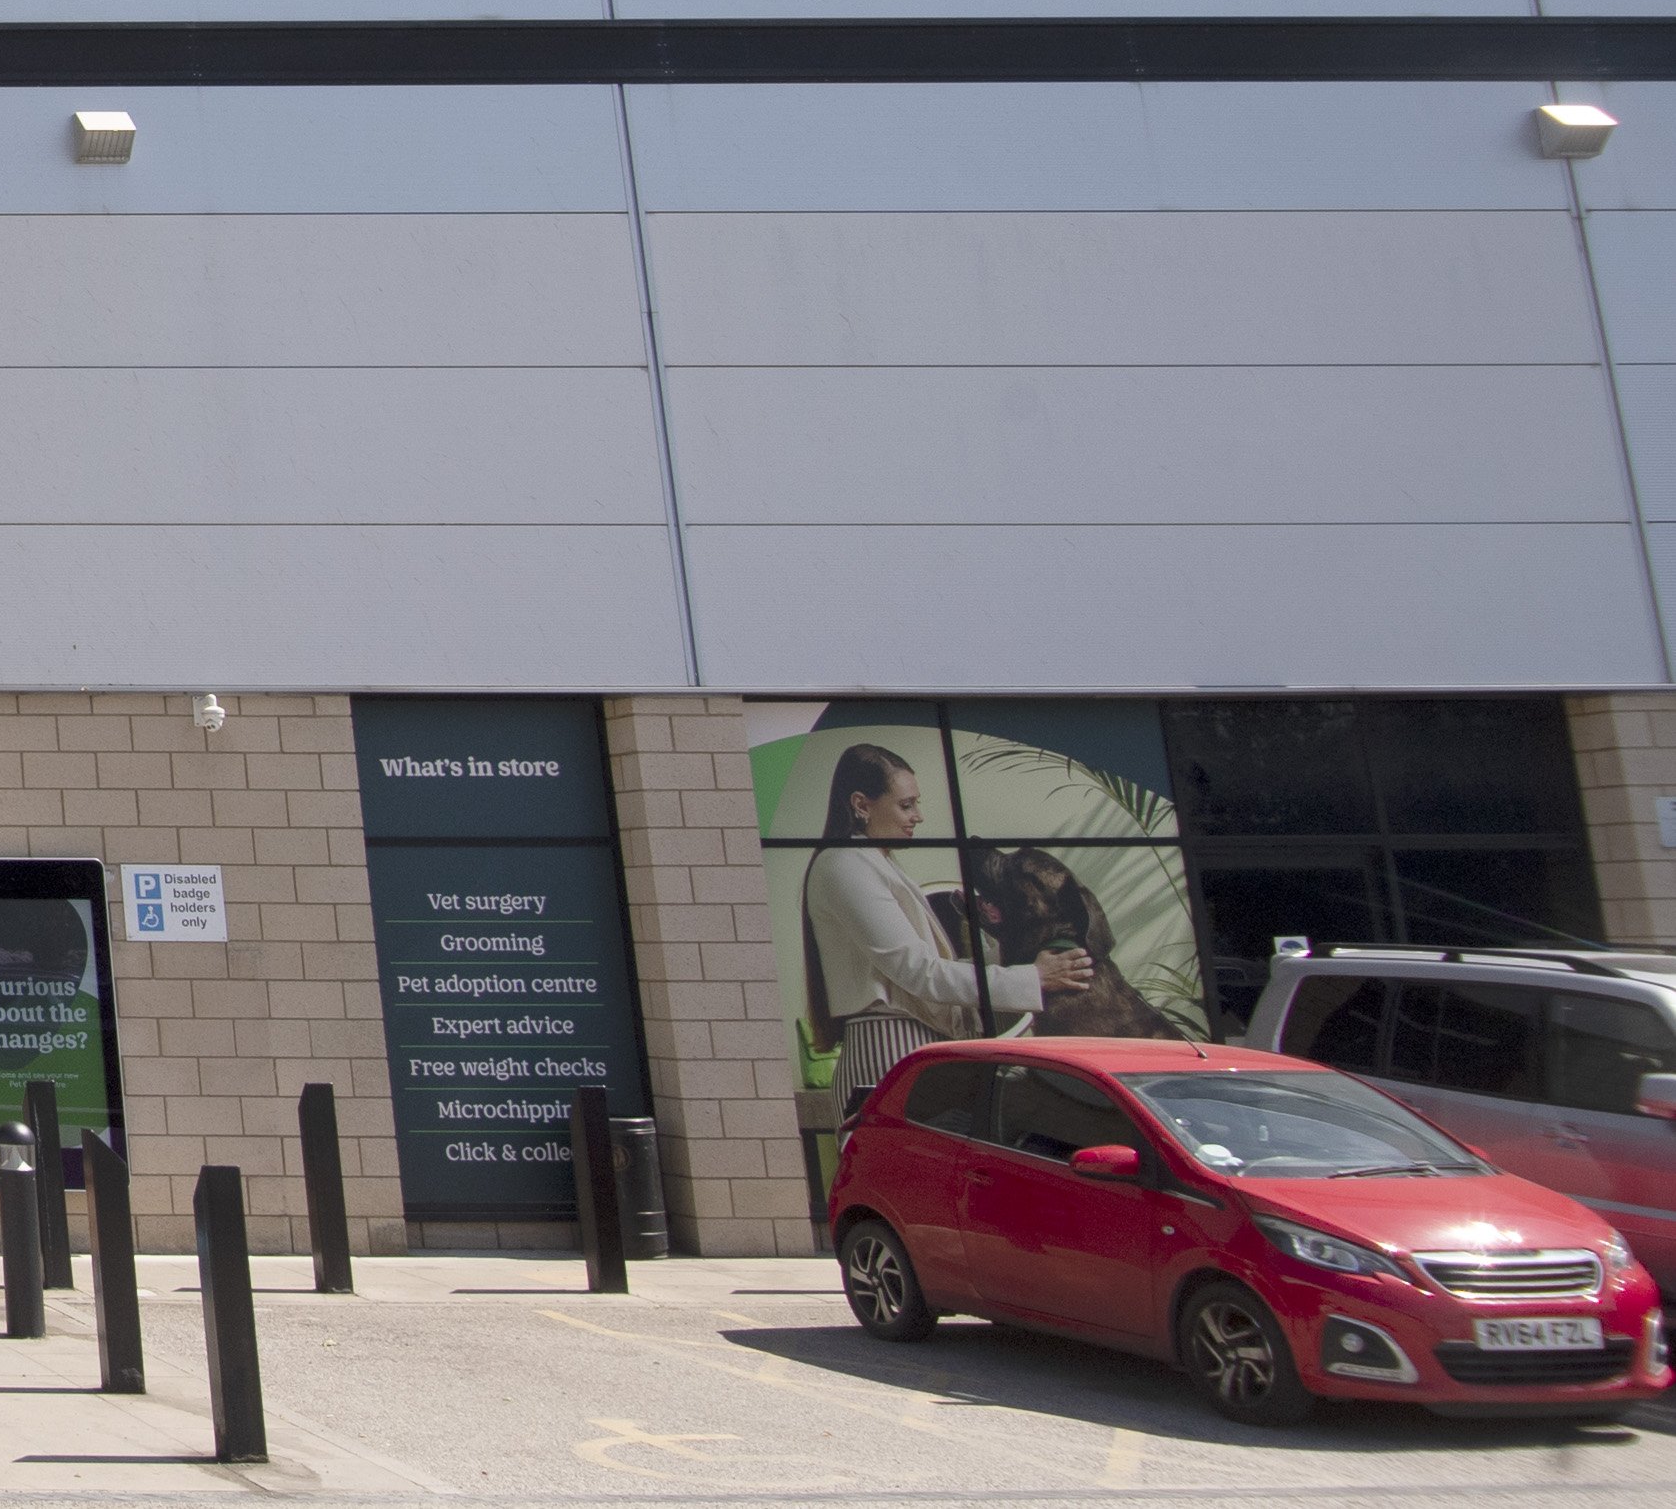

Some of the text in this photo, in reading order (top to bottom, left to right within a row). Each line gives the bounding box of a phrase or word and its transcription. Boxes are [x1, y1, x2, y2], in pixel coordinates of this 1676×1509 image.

[467, 756, 494, 777] in
[498, 758, 560, 777] store
[139, 876, 156, 897] P
[164, 874, 216, 884] Disabled
[173, 889, 210, 901] badge
[427, 893, 546, 915] Vet surgery
[170, 903, 216, 913] holders
[181, 917, 207, 930] only
[440, 933, 546, 956] Grooming
[397, 974, 598, 997] Pet adoption centre
[49, 1003, 86, 1022] the
[432, 1016, 575, 1038] Expert advice
[409, 1057, 607, 1081] Free weight checks
[446, 1142, 572, 1161] Click & colle
